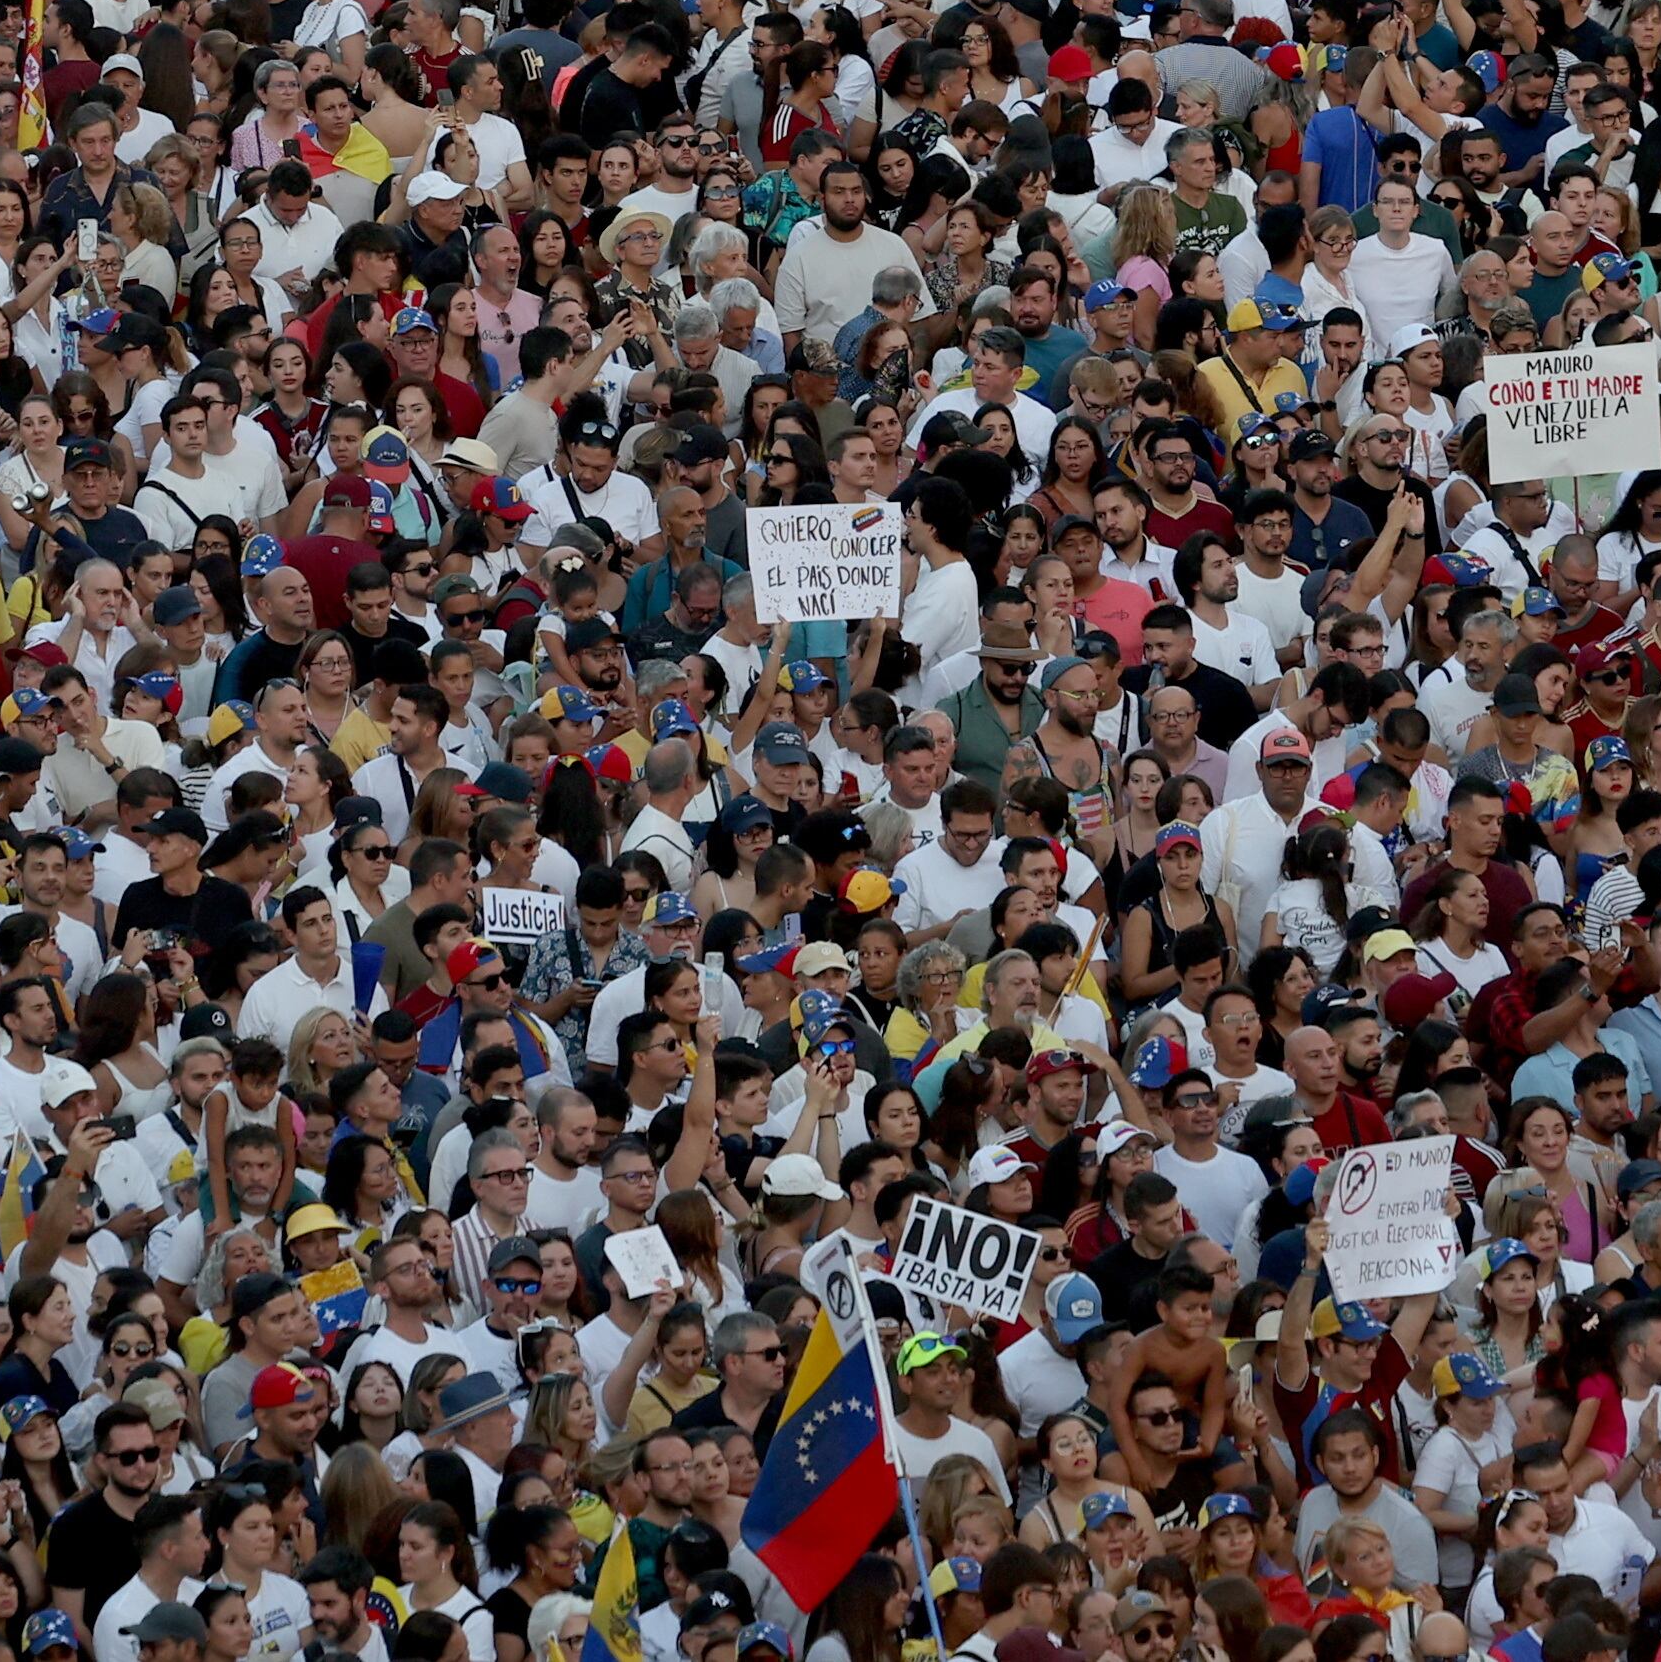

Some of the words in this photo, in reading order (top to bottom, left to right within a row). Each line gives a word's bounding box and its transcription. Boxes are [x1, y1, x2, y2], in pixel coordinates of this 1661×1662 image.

[1526, 354, 1594, 377] MADURO
[1489, 379, 1535, 407] COÑO
[1556, 379, 1580, 399] TU
[1586, 374, 1643, 398] MADRE
[1505, 396, 1630, 430] VENEZUELA
[1534, 422, 1588, 444] LIBRE
[830, 534, 897, 561] CONOCER
[768, 565, 786, 588] EL
[837, 566, 894, 587] DONDE
[798, 588, 837, 617] NACÍ
[487, 894, 563, 933] Justicia!
[1409, 1145, 1451, 1168] MUNDO
[1377, 1202, 1419, 1220] ENTERO
[902, 1198, 1037, 1292] ¡NO!
[1328, 1229, 1380, 1250] JUSTICIA
[1386, 1224, 1450, 1244] ELECTORAL
[894, 1258, 975, 1304] ¡BASTA
[1359, 1258, 1436, 1285] REACCIONA
